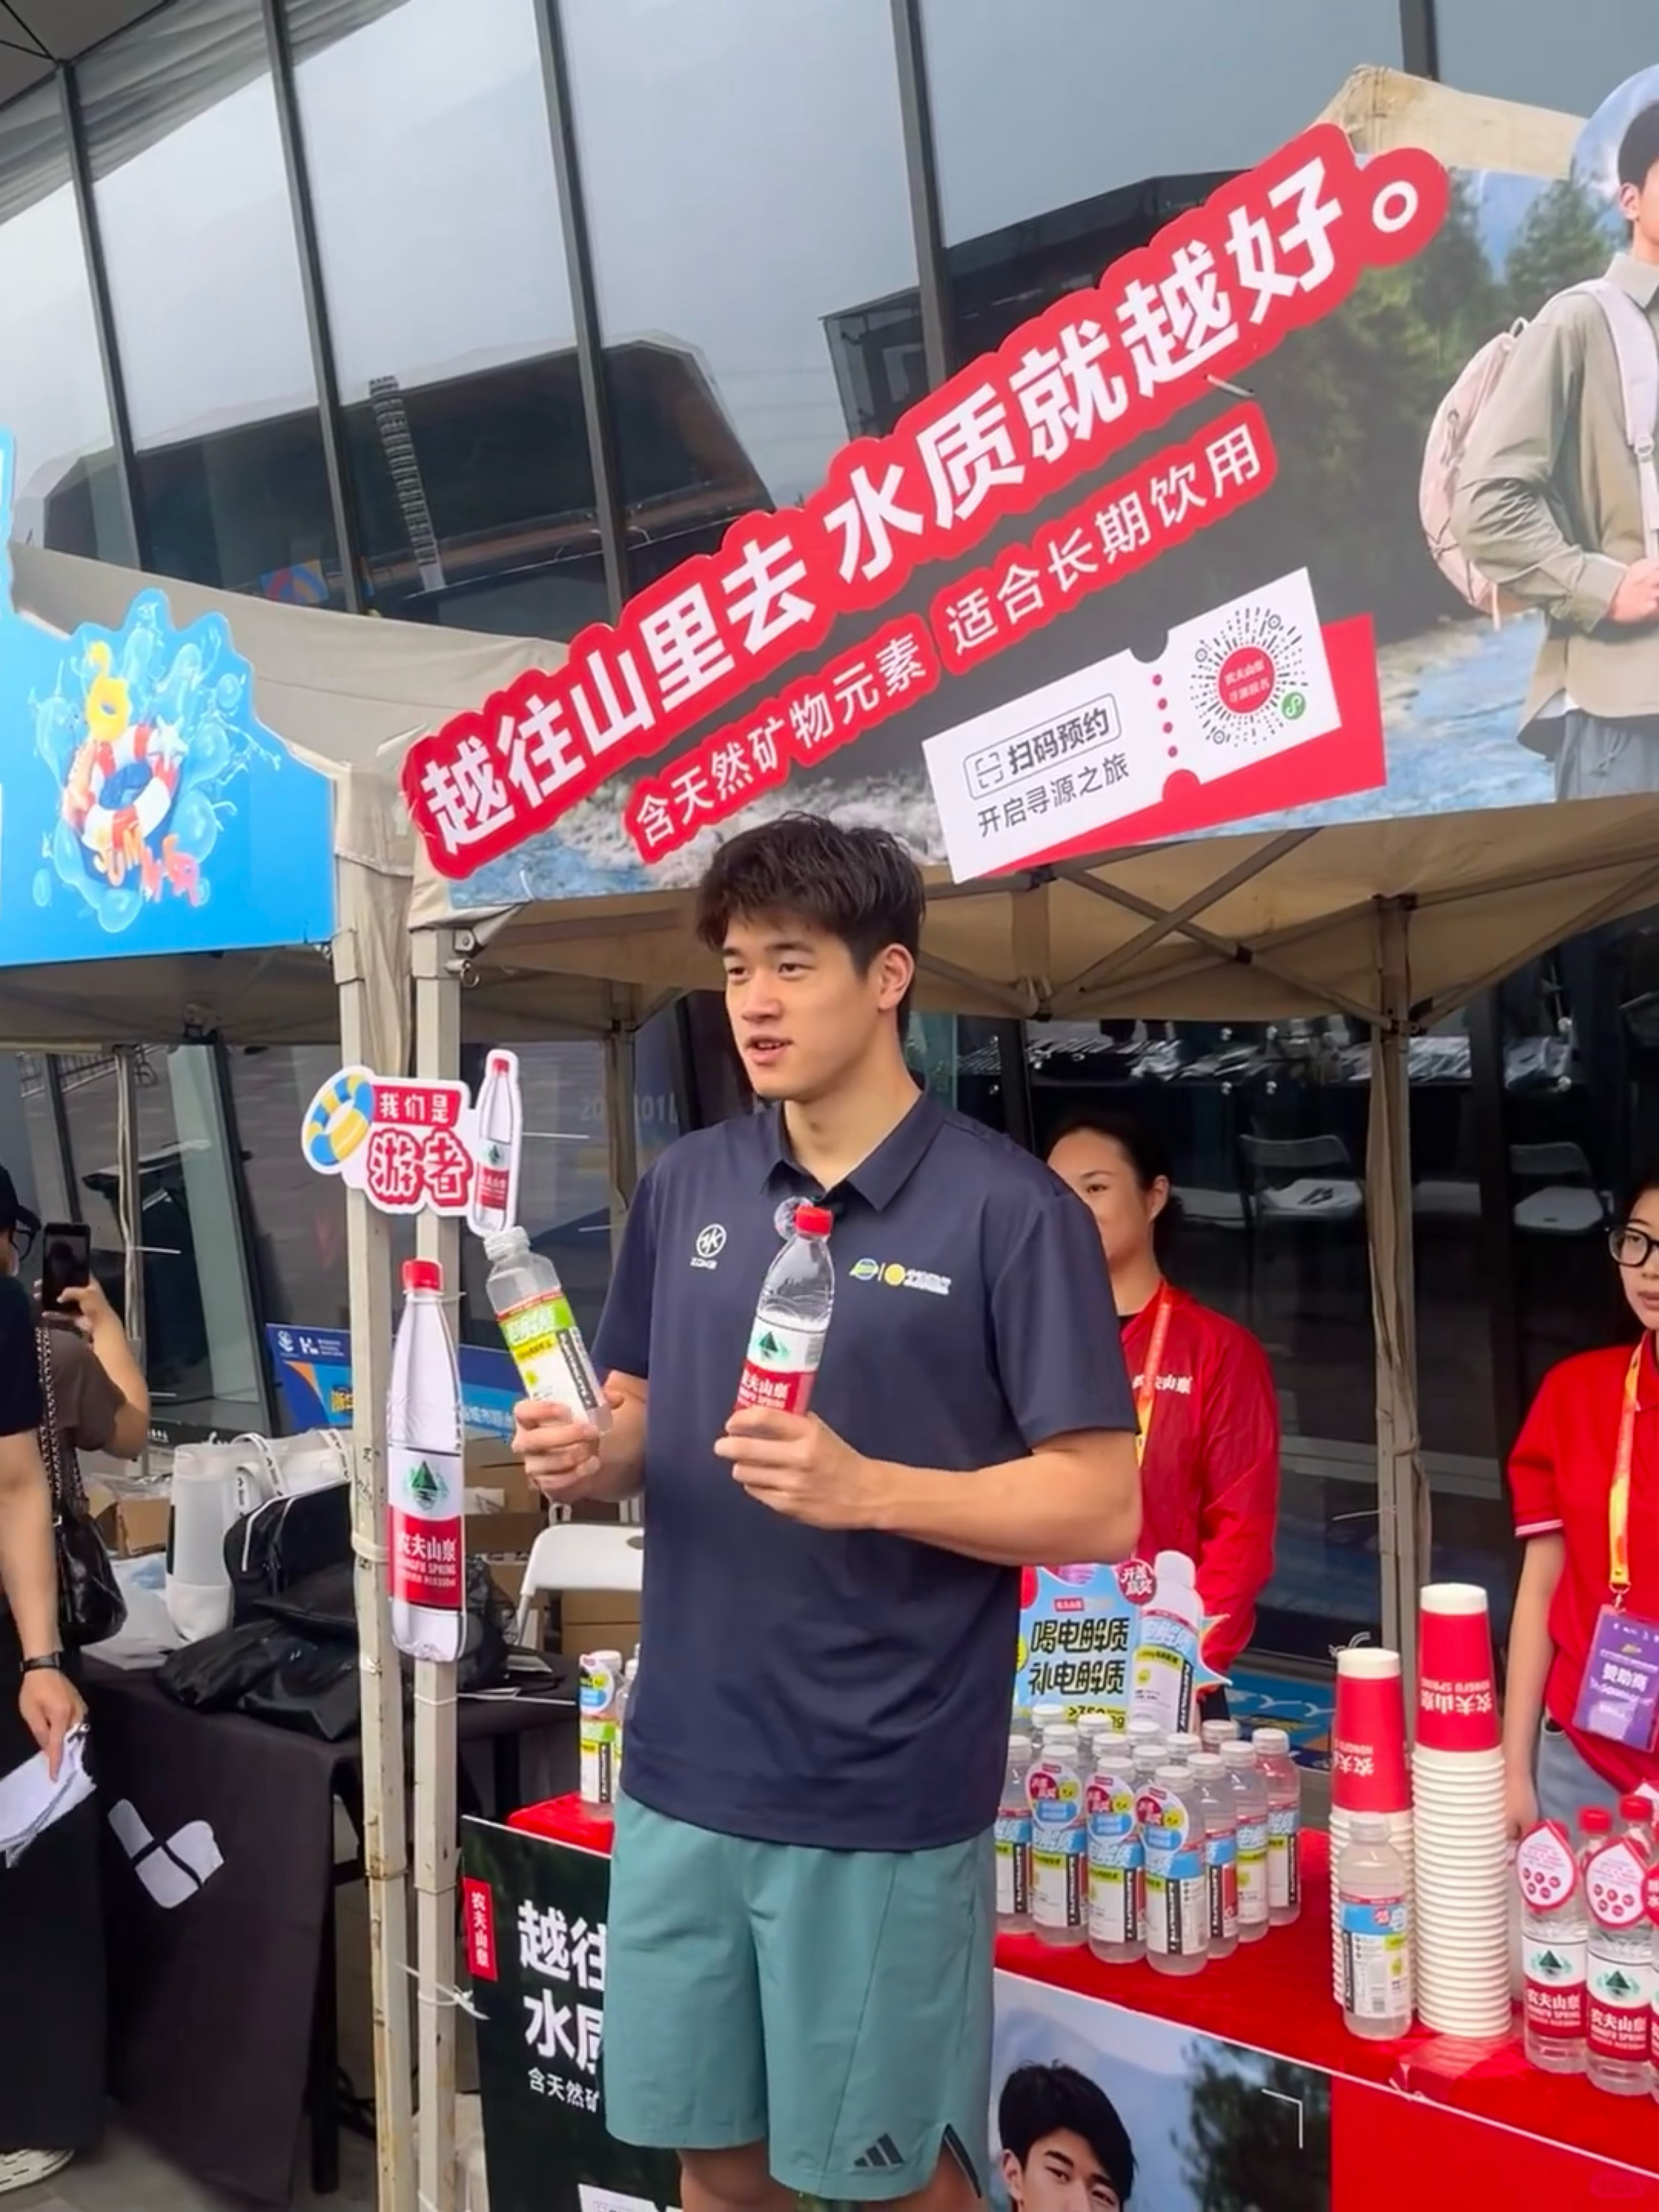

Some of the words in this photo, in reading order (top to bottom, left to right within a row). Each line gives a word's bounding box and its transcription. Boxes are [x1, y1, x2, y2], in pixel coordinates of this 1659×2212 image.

[421, 536, 815, 854] 越往山里去
[824, 156, 1418, 583] 水质就越好。
[636, 633, 926, 846] 含天然矿物元素
[948, 423, 1261, 654] 适合长期饮用
[1008, 708, 1110, 774] 扫码预约
[977, 753, 1129, 838] 开启寻源之旅
[380, 1092, 449, 1123] 我们是
[370, 1129, 471, 1204] 游者
[1030, 1617, 1130, 1654] 喝电解质
[1028, 1660, 1126, 1696] 补电解质
